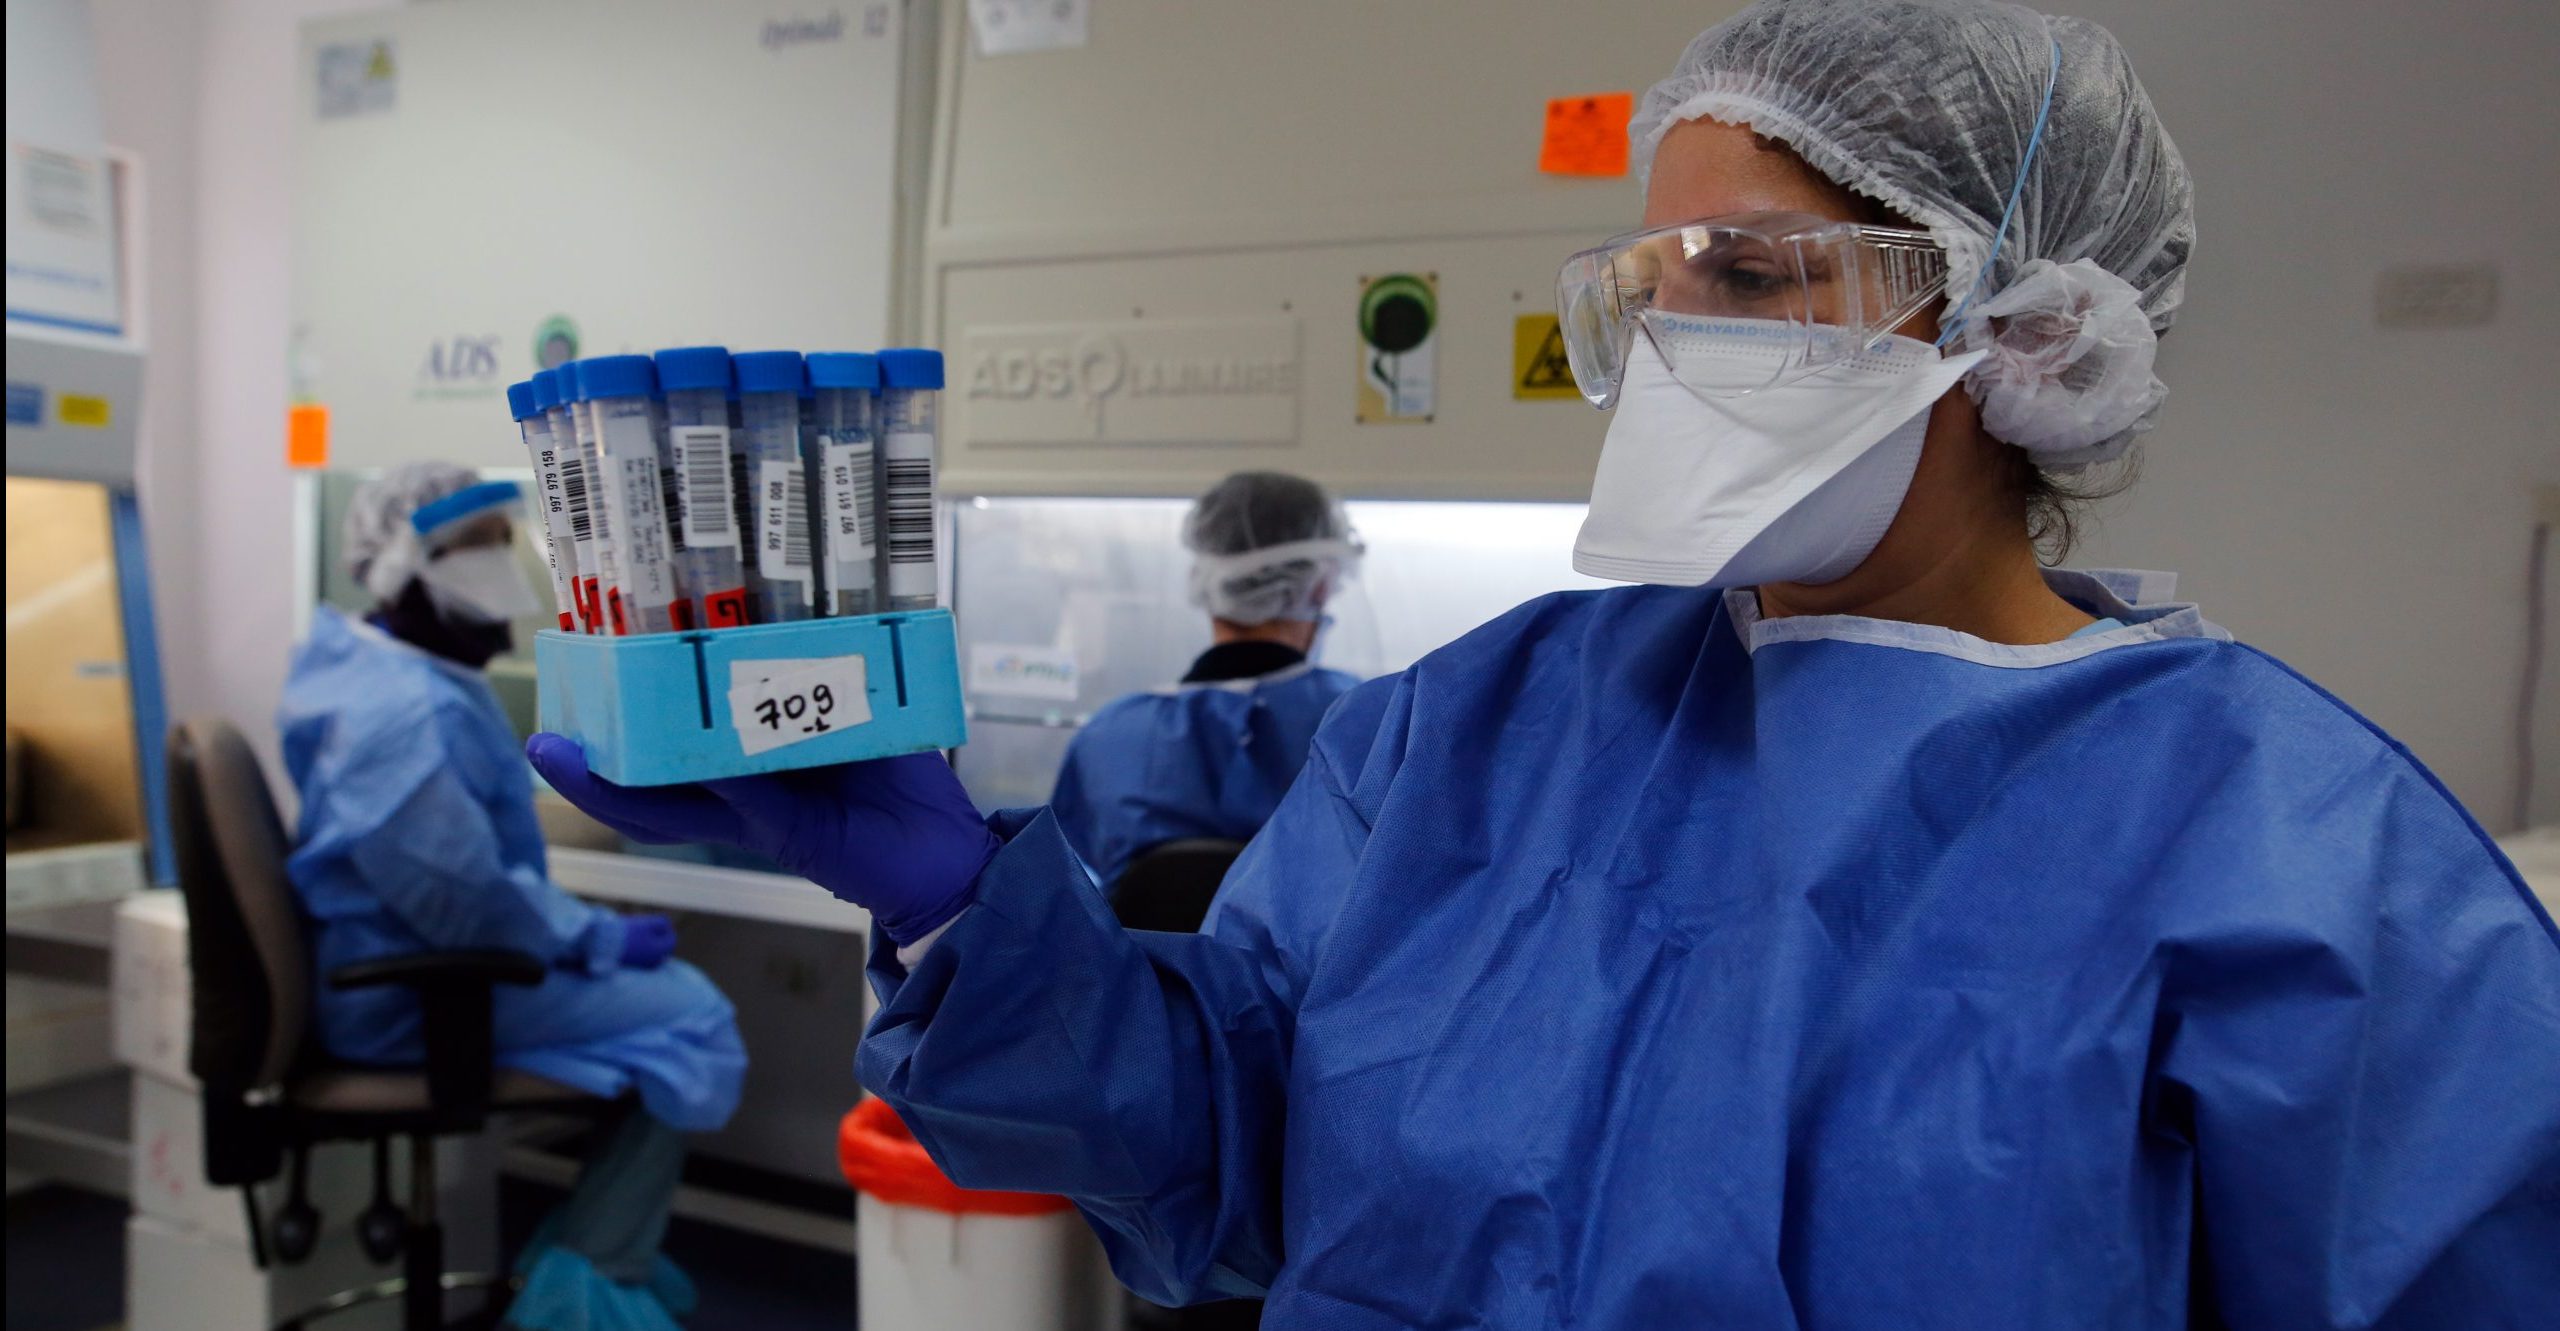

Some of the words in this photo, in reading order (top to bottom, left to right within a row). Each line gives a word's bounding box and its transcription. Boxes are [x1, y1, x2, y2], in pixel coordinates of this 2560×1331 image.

[1680, 320, 1758, 337] HALYARD
[541, 450, 554, 468] 158
[545, 473, 559, 491] 979
[550, 495, 562, 513] 997
[838, 491, 851, 510] 611
[769, 507, 782, 526] 611
[842, 516, 855, 535] 997
[768, 530, 781, 550] 997
[755, 684, 834, 731] 709
